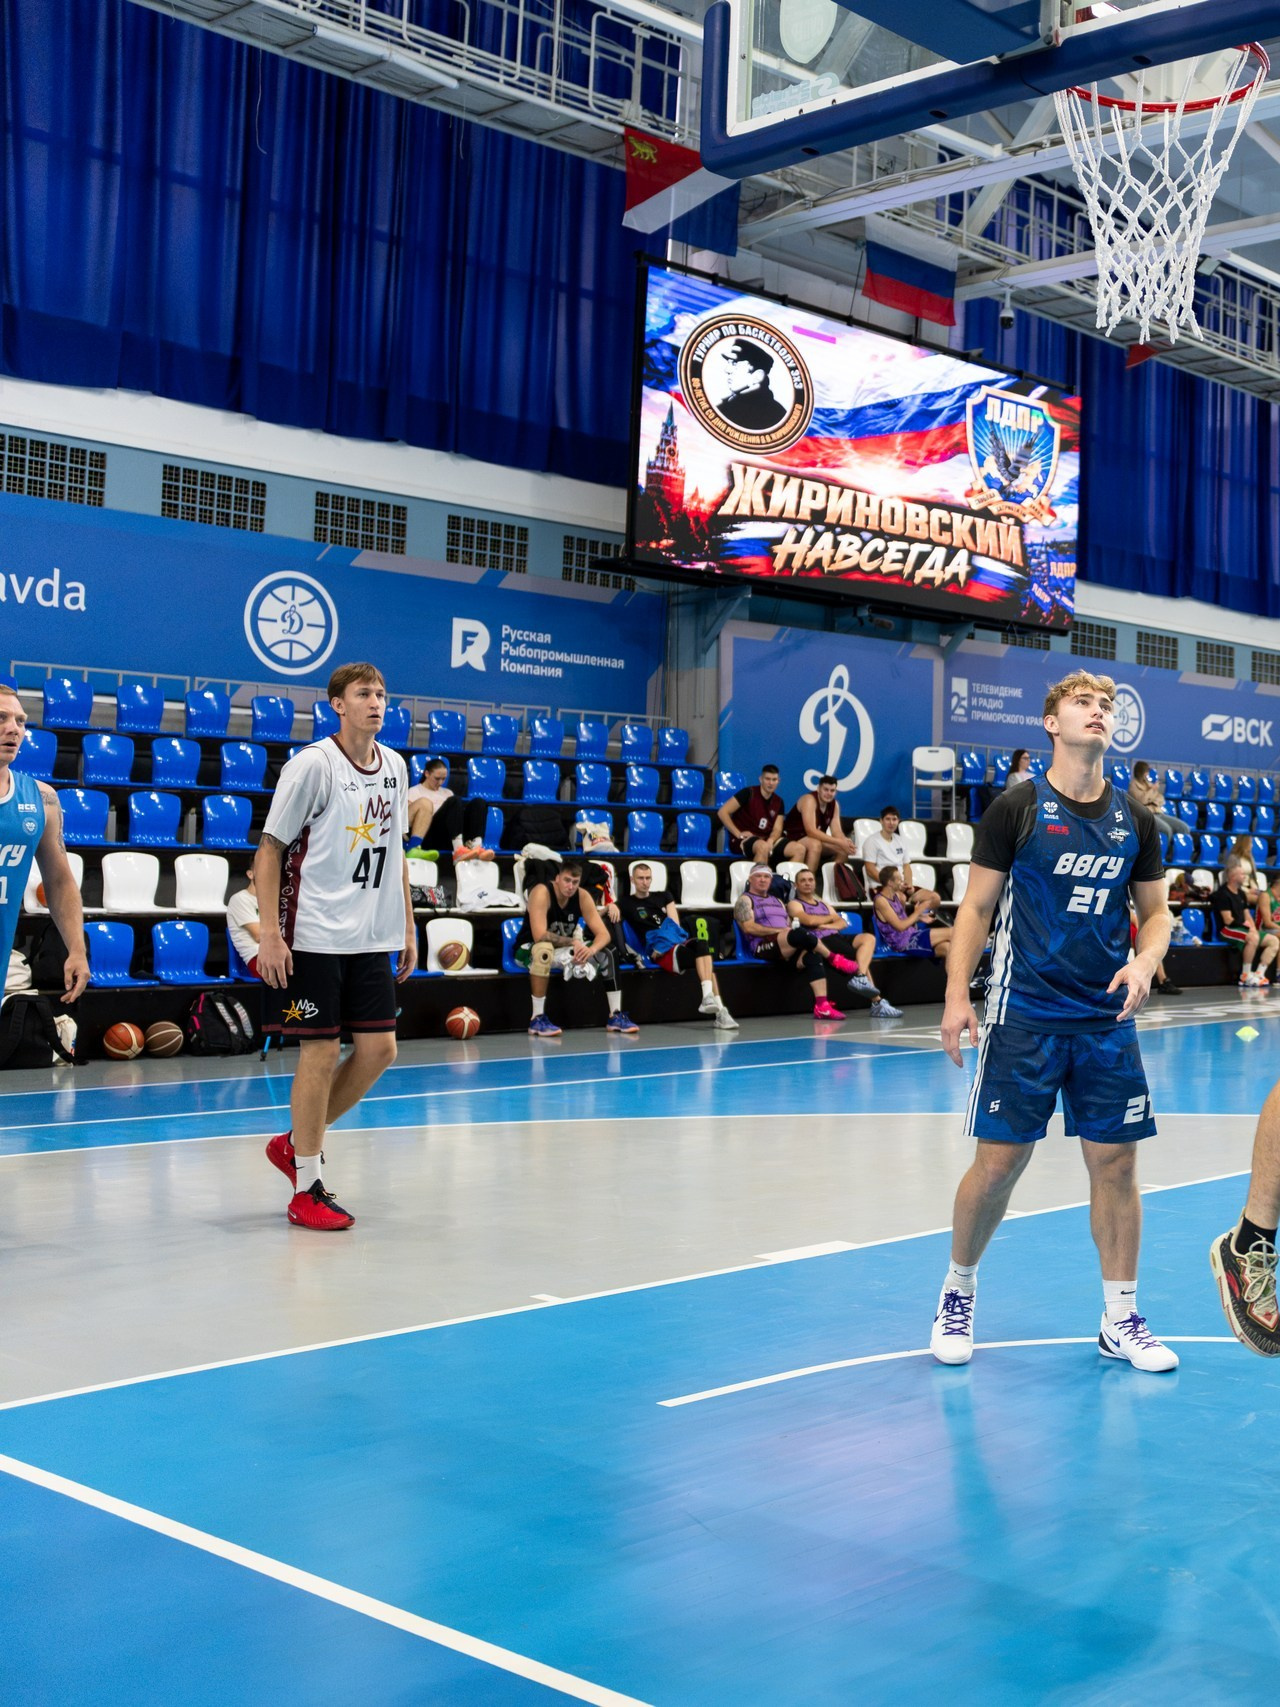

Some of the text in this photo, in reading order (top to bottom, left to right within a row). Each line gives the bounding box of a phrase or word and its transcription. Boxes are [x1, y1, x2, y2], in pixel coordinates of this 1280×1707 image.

[693, 329, 721, 363] ТУРНИР
[721, 324, 737, 336] ПО
[985, 396, 1044, 434] ЛДПР
[717, 462, 1024, 568] ЖИРИНОВСКИЙ
[771, 524, 972, 588] НАВСЕГДА
[502, 624, 551, 644] Русская
[500, 658, 562, 678] Компания
[501, 641, 625, 669] Рыбопромышленная
[971, 682, 1023, 698] ТЕЛЕВИДЕНИЕ
[978, 697, 1003, 710] РАДИО
[971, 710, 1024, 725] ПРИМОРСКОГО
[1233, 716, 1274, 747] ВСК
[352, 846, 387, 889] 47
[1066, 885, 1110, 915] 21
[695, 917, 709, 941] 8
